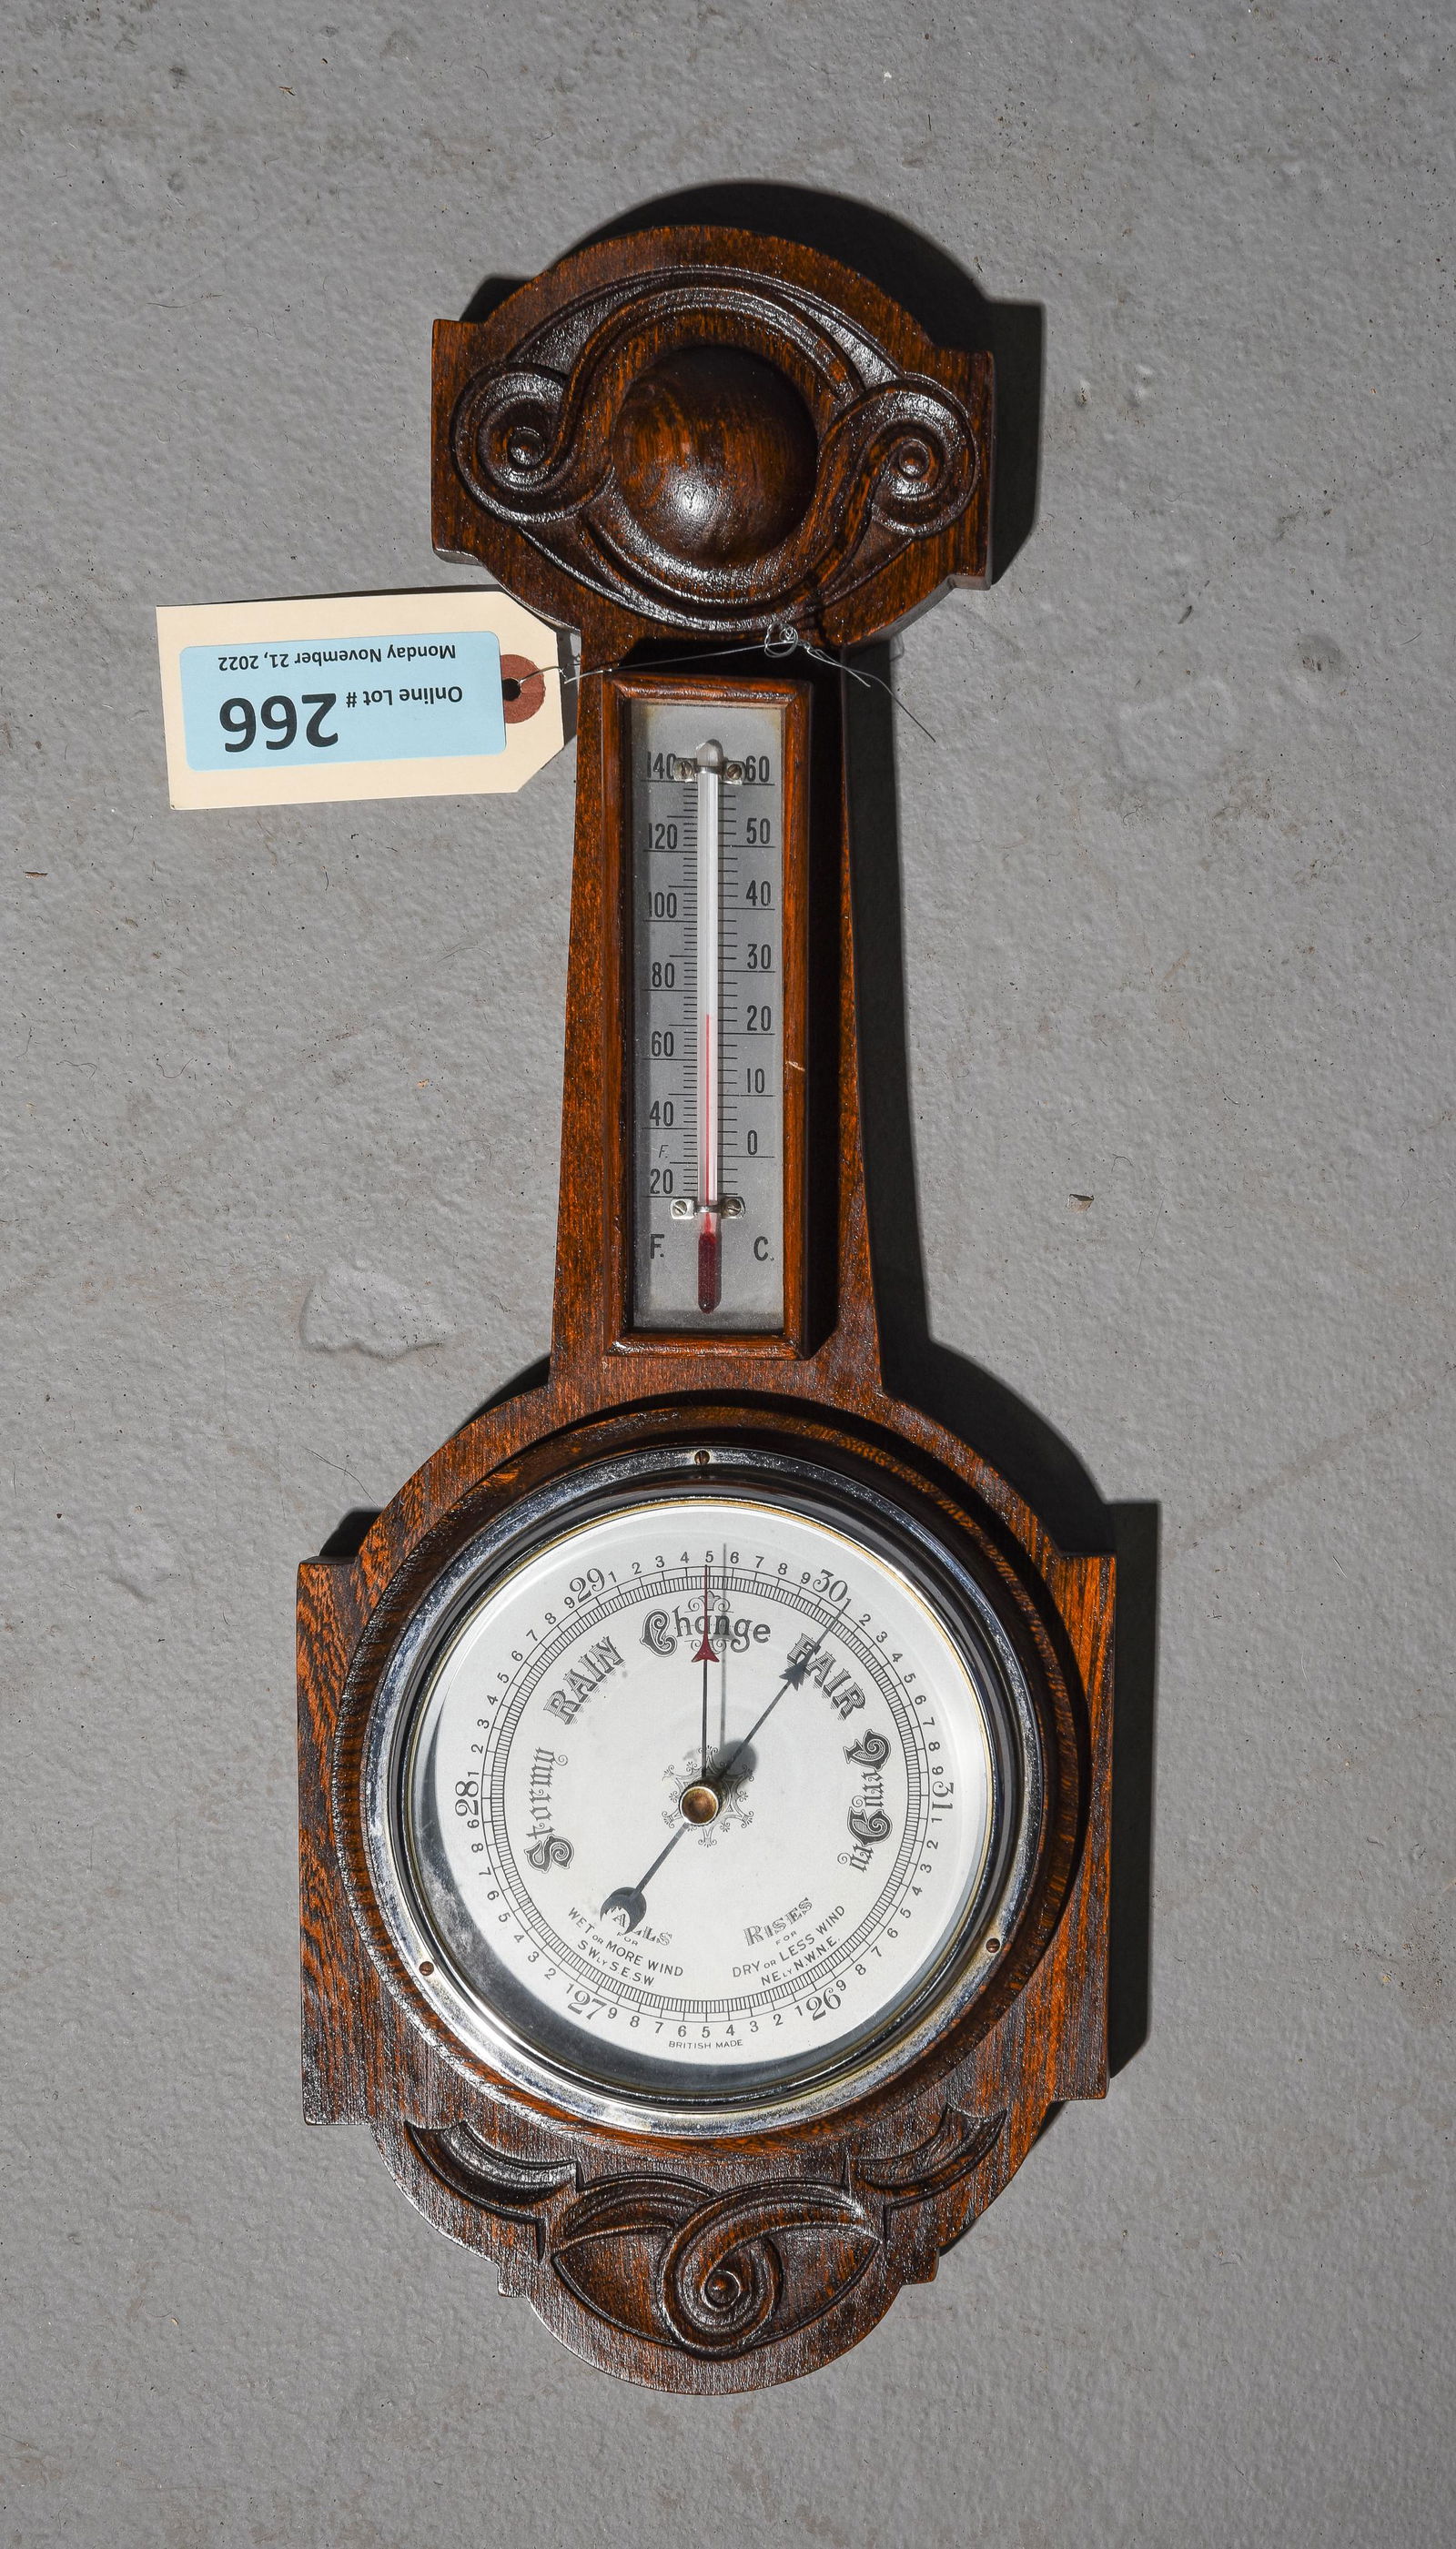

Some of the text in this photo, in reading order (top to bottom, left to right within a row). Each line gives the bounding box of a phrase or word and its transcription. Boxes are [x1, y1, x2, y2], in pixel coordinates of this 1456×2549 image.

[217, 644, 456, 672] Monday November 21, 2022
[219, 685, 463, 754] Online Lot # 266
[745, 755, 771, 783] 60
[648, 823, 678, 850] 120
[746, 817, 771, 845] 50
[746, 880, 772, 906] 40
[648, 892, 677, 918] 100
[747, 944, 772, 969] 30
[652, 961, 675, 988] 80
[747, 1005, 772, 1031] 20
[651, 1030, 674, 1057] 60
[747, 1068, 765, 1094] 10
[649, 1100, 674, 1127] 40
[747, 1129, 758, 1156] 0
[650, 1168, 673, 1195] 20
[650, 1233, 665, 1259] F.
[753, 1236, 775, 1261] C.
[654, 1555, 665, 1569] 3
[679, 1551, 690, 1564] 4
[704, 1550, 714, 1563] 5
[729, 1551, 740, 1564] 6
[754, 1554, 765, 1569] 7
[631, 1562, 642, 1575] 2
[777, 1562, 788, 1576] 8
[607, 1570, 617, 1583] 1
[799, 1572, 812, 1585] 9
[569, 1567, 605, 1603] 29
[812, 1568, 850, 1603] 30
[563, 1596, 576, 1609] 9
[544, 1612, 557, 1625] 8
[858, 1613, 872, 1627] 2
[525, 1628, 539, 1642] 7
[639, 1605, 771, 1657] Change
[875, 1631, 888, 1644] 3
[511, 1650, 524, 1662] 6
[891, 1653, 904, 1664] 4
[496, 1672, 510, 1684] 5
[543, 1635, 626, 1725] RAIN
[786, 1633, 865, 1721] FAIR
[903, 1672, 916, 1684] 5
[486, 1694, 499, 1706] 4
[914, 1694, 927, 1705] 6
[476, 1718, 490, 1730] 3
[922, 1716, 935, 1726] 7
[470, 1744, 484, 1755] 2
[927, 1741, 941, 1753] 8
[931, 1765, 945, 1776] 9
[454, 1780, 480, 1817] 28
[837, 1728, 894, 1873] Very Dry
[931, 1780, 955, 1811] 31
[523, 1746, 575, 1874] Stormy
[470, 1842, 484, 1854] 8
[925, 1839, 939, 1850] 2
[478, 1866, 492, 1876] 7
[919, 1863, 933, 1874] 3
[486, 1889, 500, 1901] 6
[911, 1886, 923, 1897] 4
[498, 1912, 511, 1923] 5
[899, 1907, 912, 1919] 5
[743, 1897, 813, 1947] RISES
[513, 1933, 525, 1945] 4
[775, 1930, 798, 1946] FOR
[886, 1927, 899, 1938] 6
[568, 1907, 684, 1977] WET OR MORE WIND
[732, 1905, 844, 1977] DRY OR LESS WIND
[527, 1950, 540, 1963] 3
[870, 1945, 883, 1957] 7
[543, 1967, 557, 1980] 2
[854, 1963, 867, 1976] 8
[566, 1983, 575, 1995] 1
[835, 1979, 847, 1992] 9
[567, 1989, 608, 2021] 27
[794, 2005, 804, 2017] 1
[805, 1987, 842, 2022] 26
[607, 2007, 618, 2019] 9
[629, 2015, 641, 2028] 8
[749, 2020, 759, 2033] 3
[773, 2013, 784, 2027] 2
[654, 2020, 664, 2034] 7
[677, 2025, 687, 2038] 6
[701, 2026, 711, 2038] 5
[725, 2024, 735, 2037] 4
[668, 2038, 743, 2049] BRITISH MADE
